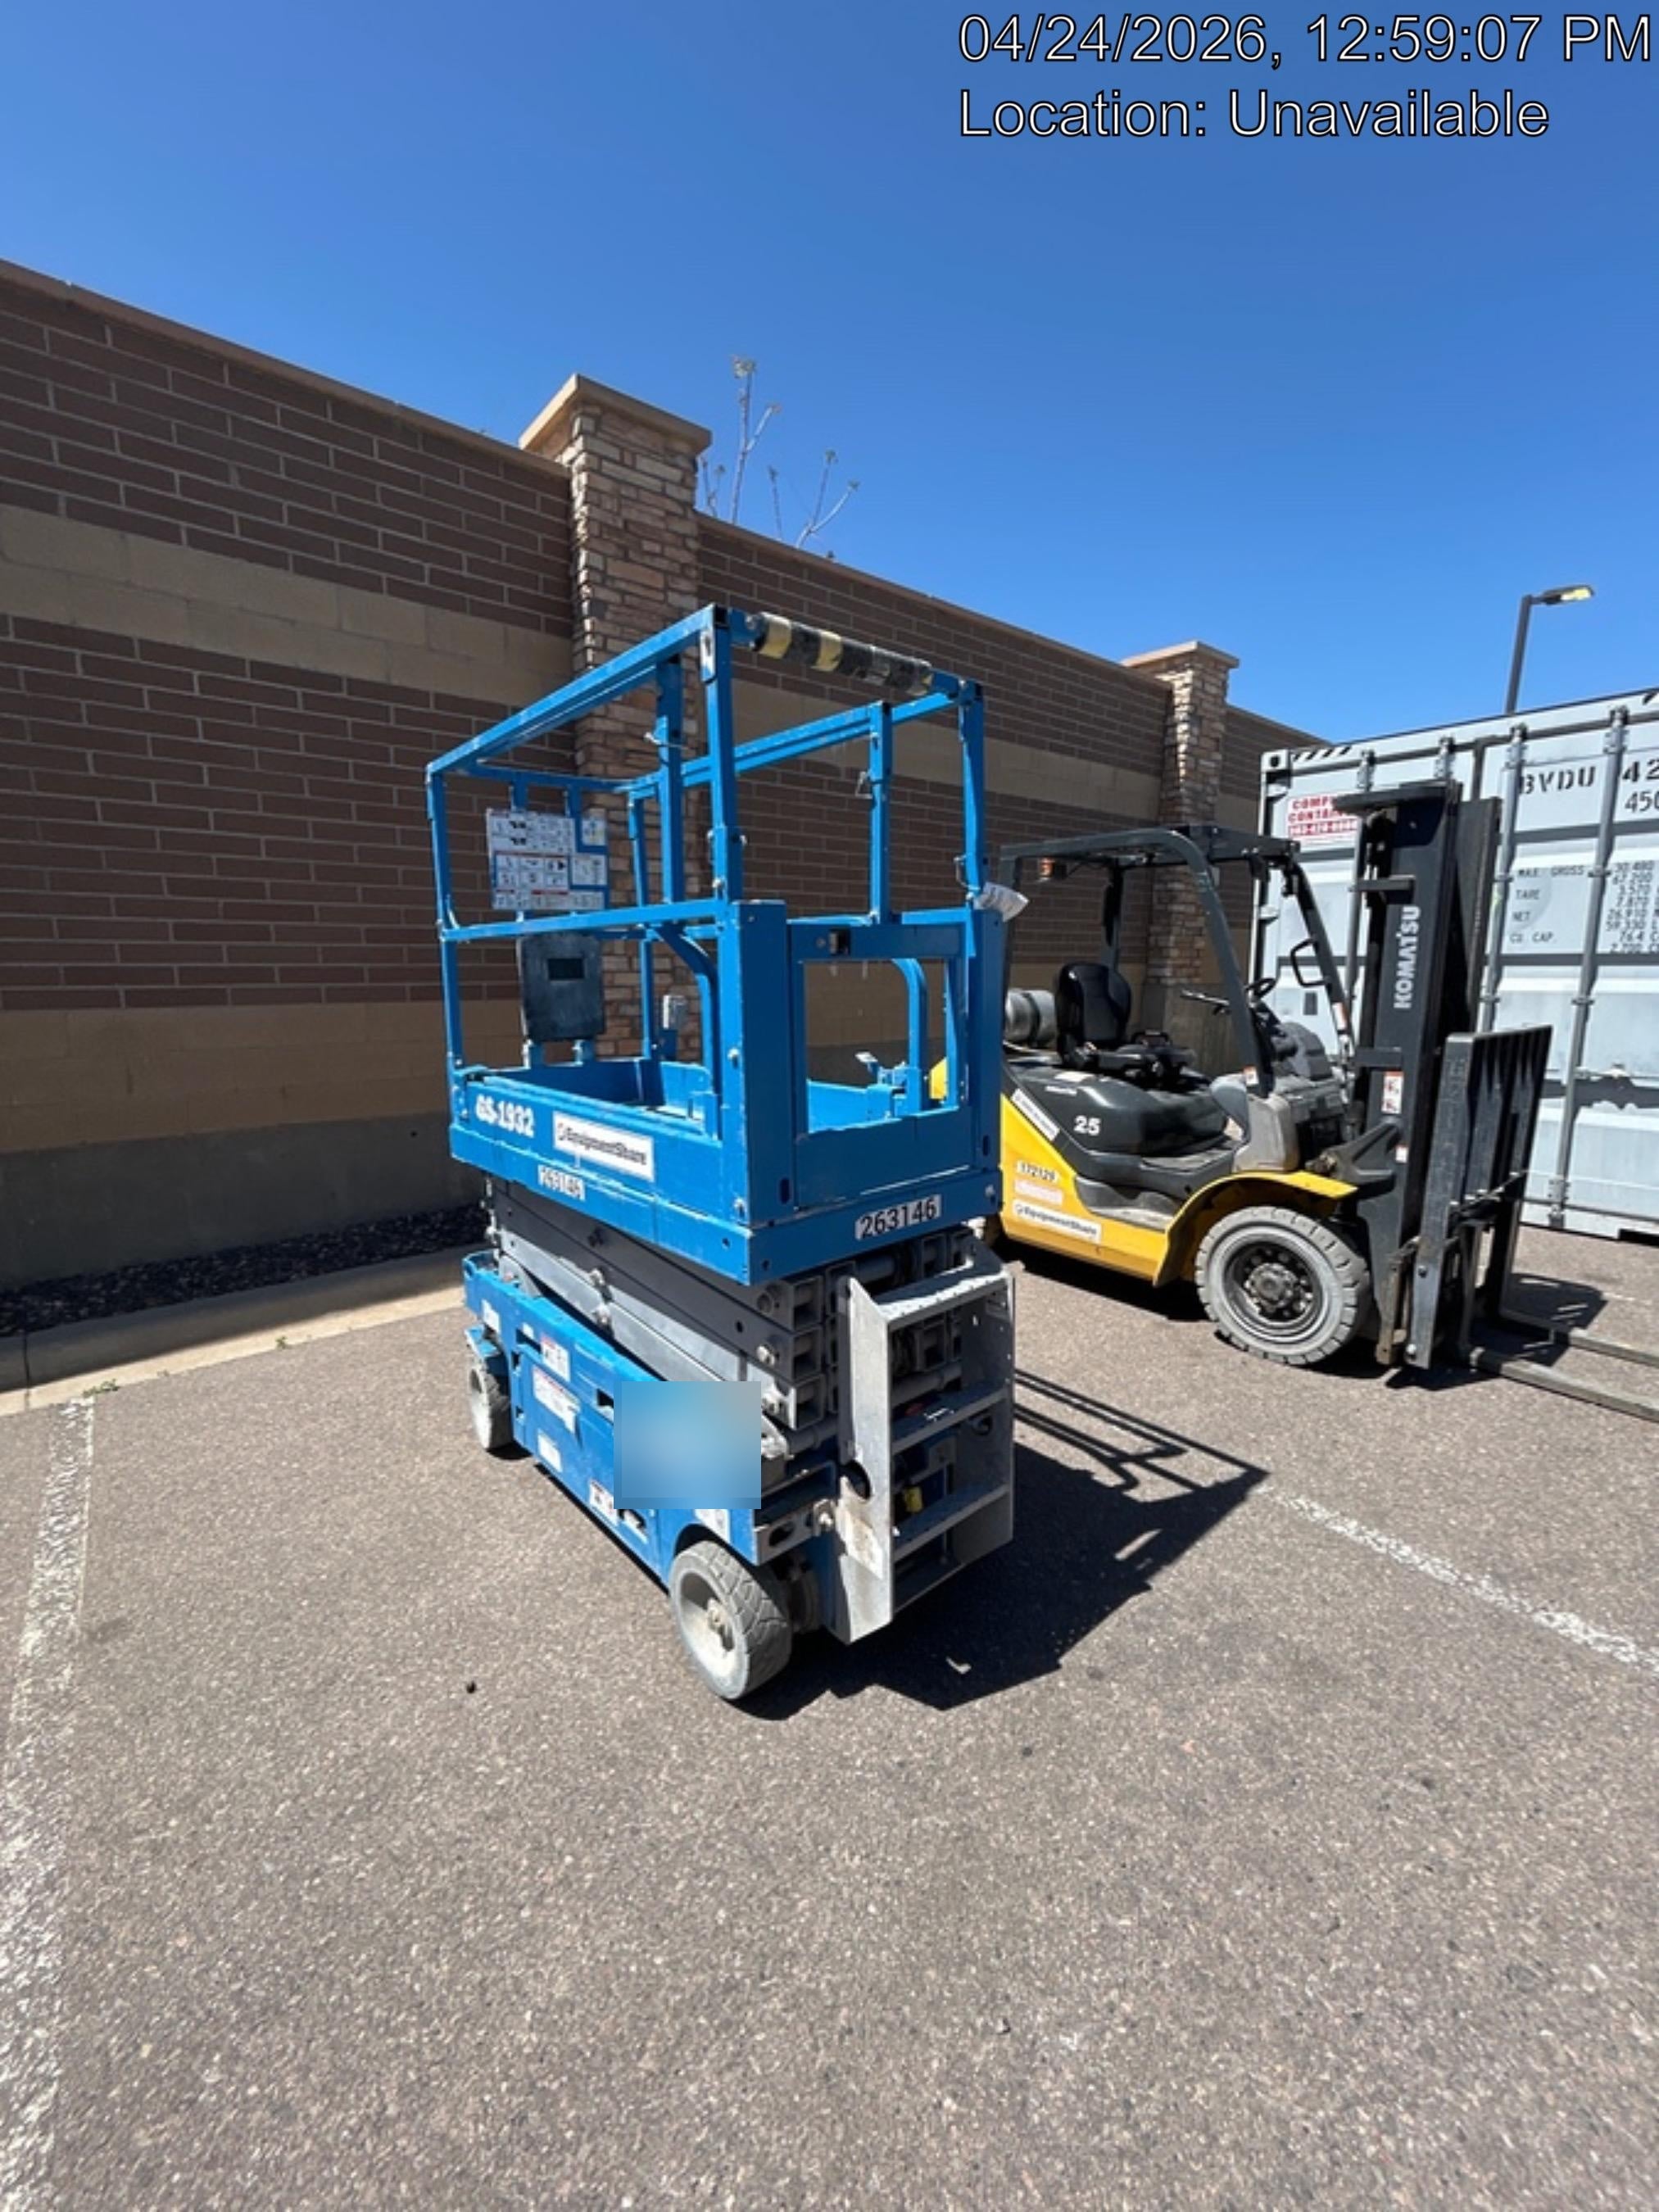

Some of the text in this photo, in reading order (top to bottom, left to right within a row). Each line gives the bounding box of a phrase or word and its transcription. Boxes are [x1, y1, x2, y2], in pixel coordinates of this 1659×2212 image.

[1394, 905, 1421, 1009] KOMATSU
[1073, 1114, 1102, 1136] 25
[860, 1198, 937, 1240] 263146
